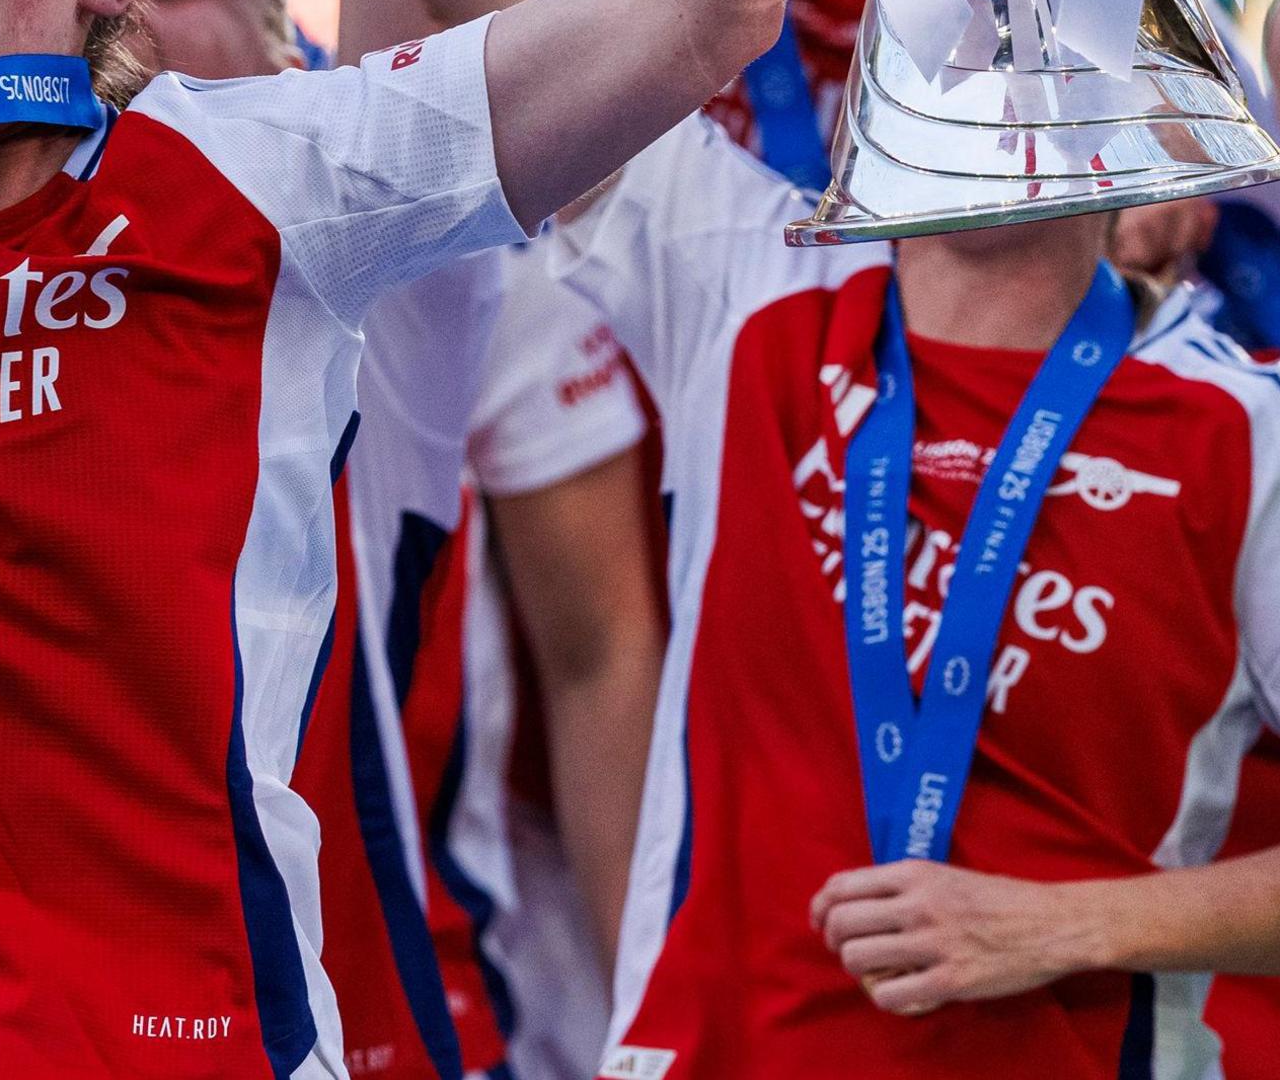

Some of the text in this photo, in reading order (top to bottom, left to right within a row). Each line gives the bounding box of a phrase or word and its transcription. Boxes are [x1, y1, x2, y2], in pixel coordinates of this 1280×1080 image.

[20, 75, 70, 104] LISBON
[1010, 408, 1063, 474] LISBON
[998, 471, 1028, 502] 25
[861, 527, 890, 558] 25
[861, 560, 889, 644] LISBON
[132, 1014, 231, 1039] HEAT.RDY
